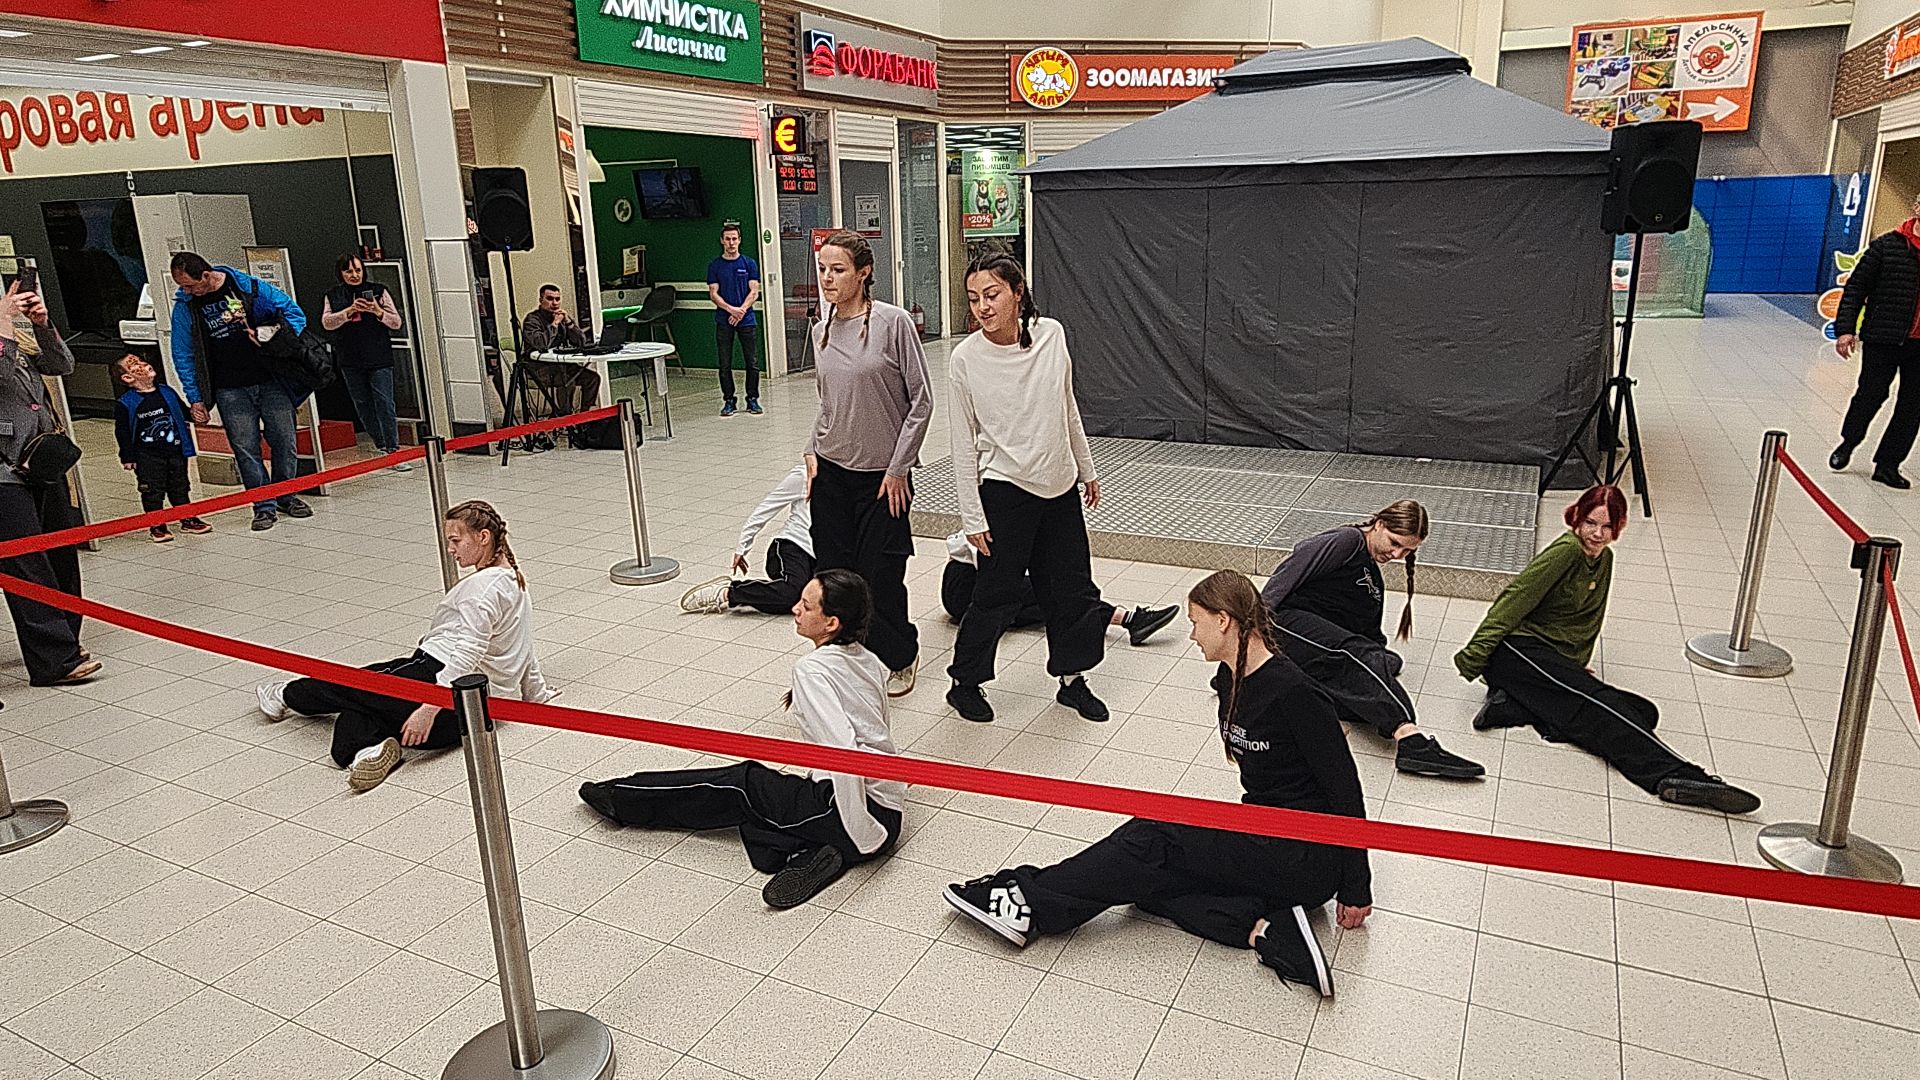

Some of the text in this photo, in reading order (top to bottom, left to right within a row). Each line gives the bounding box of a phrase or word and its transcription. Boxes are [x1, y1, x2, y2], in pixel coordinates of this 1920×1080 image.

[632, 26, 727, 63] Лисичка
[1683, 23, 1749, 51] АПЕЛЬСИНКА
[838, 40, 939, 90] ФОРАБАНК
[1025, 50, 1070, 68] ЧЕТЫРЕ
[1029, 92, 1068, 106] ЛАПЫ
